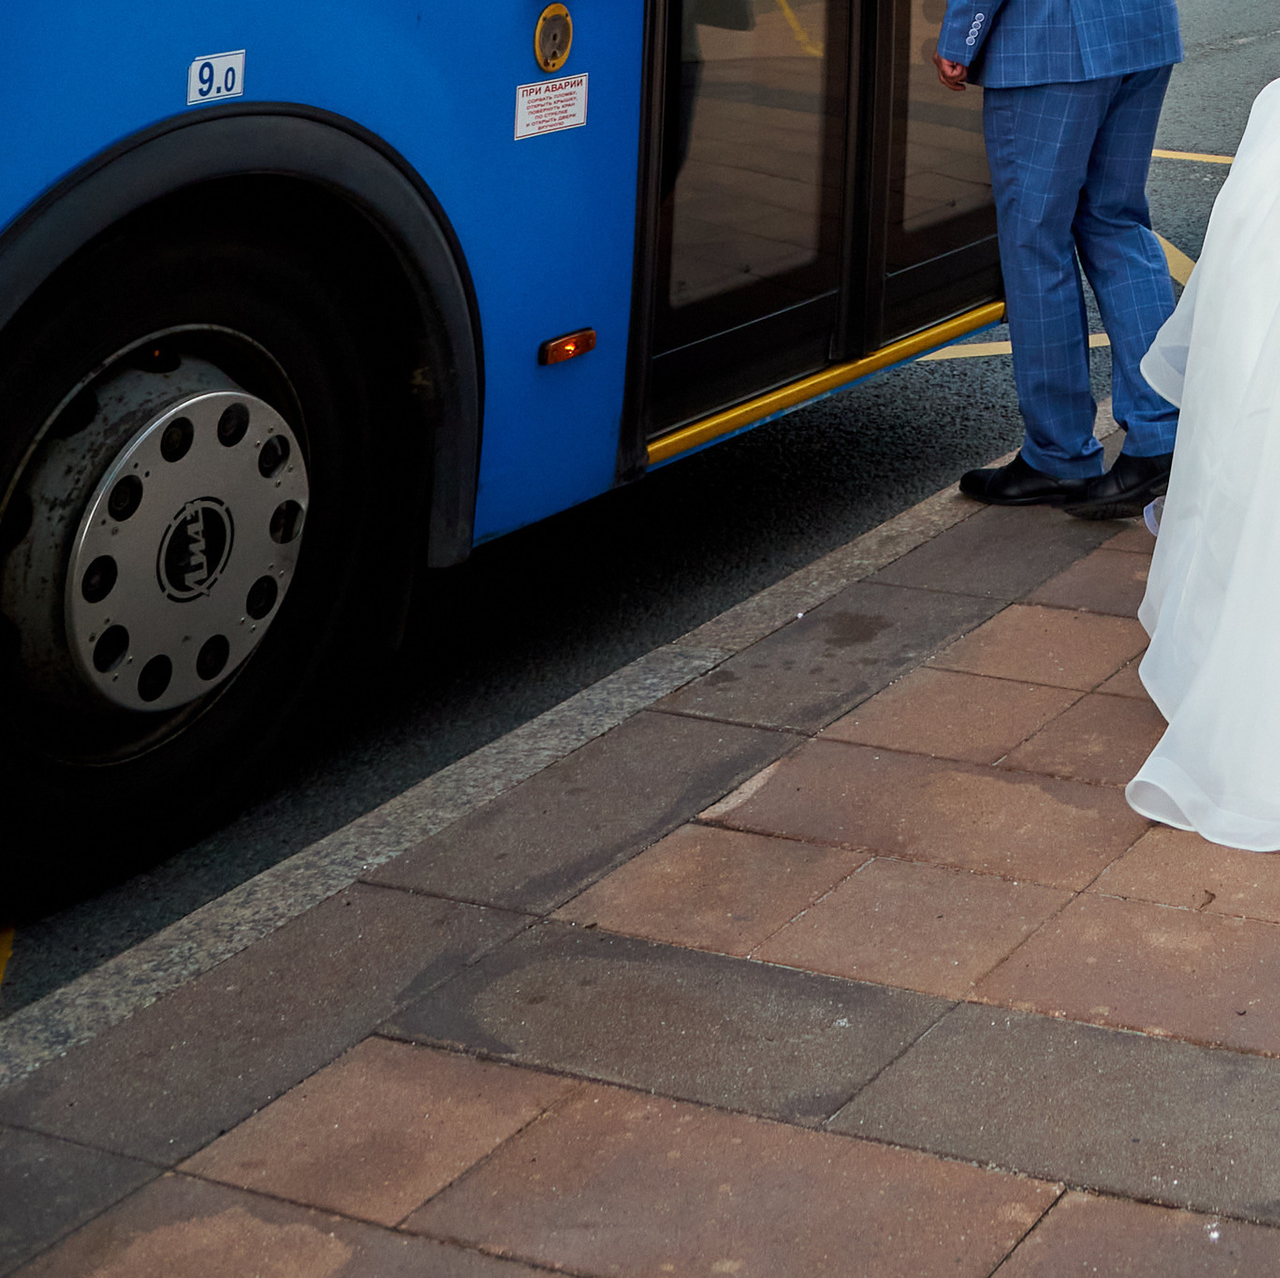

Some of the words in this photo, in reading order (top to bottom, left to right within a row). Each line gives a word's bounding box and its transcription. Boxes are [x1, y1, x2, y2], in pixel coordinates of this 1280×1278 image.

[198, 61, 236, 97] 9.0
[521, 87, 542, 98] ПРИ
[544, 78, 583, 94] АВАРИИ
[526, 101, 552, 110] ОТКРЫТЬ
